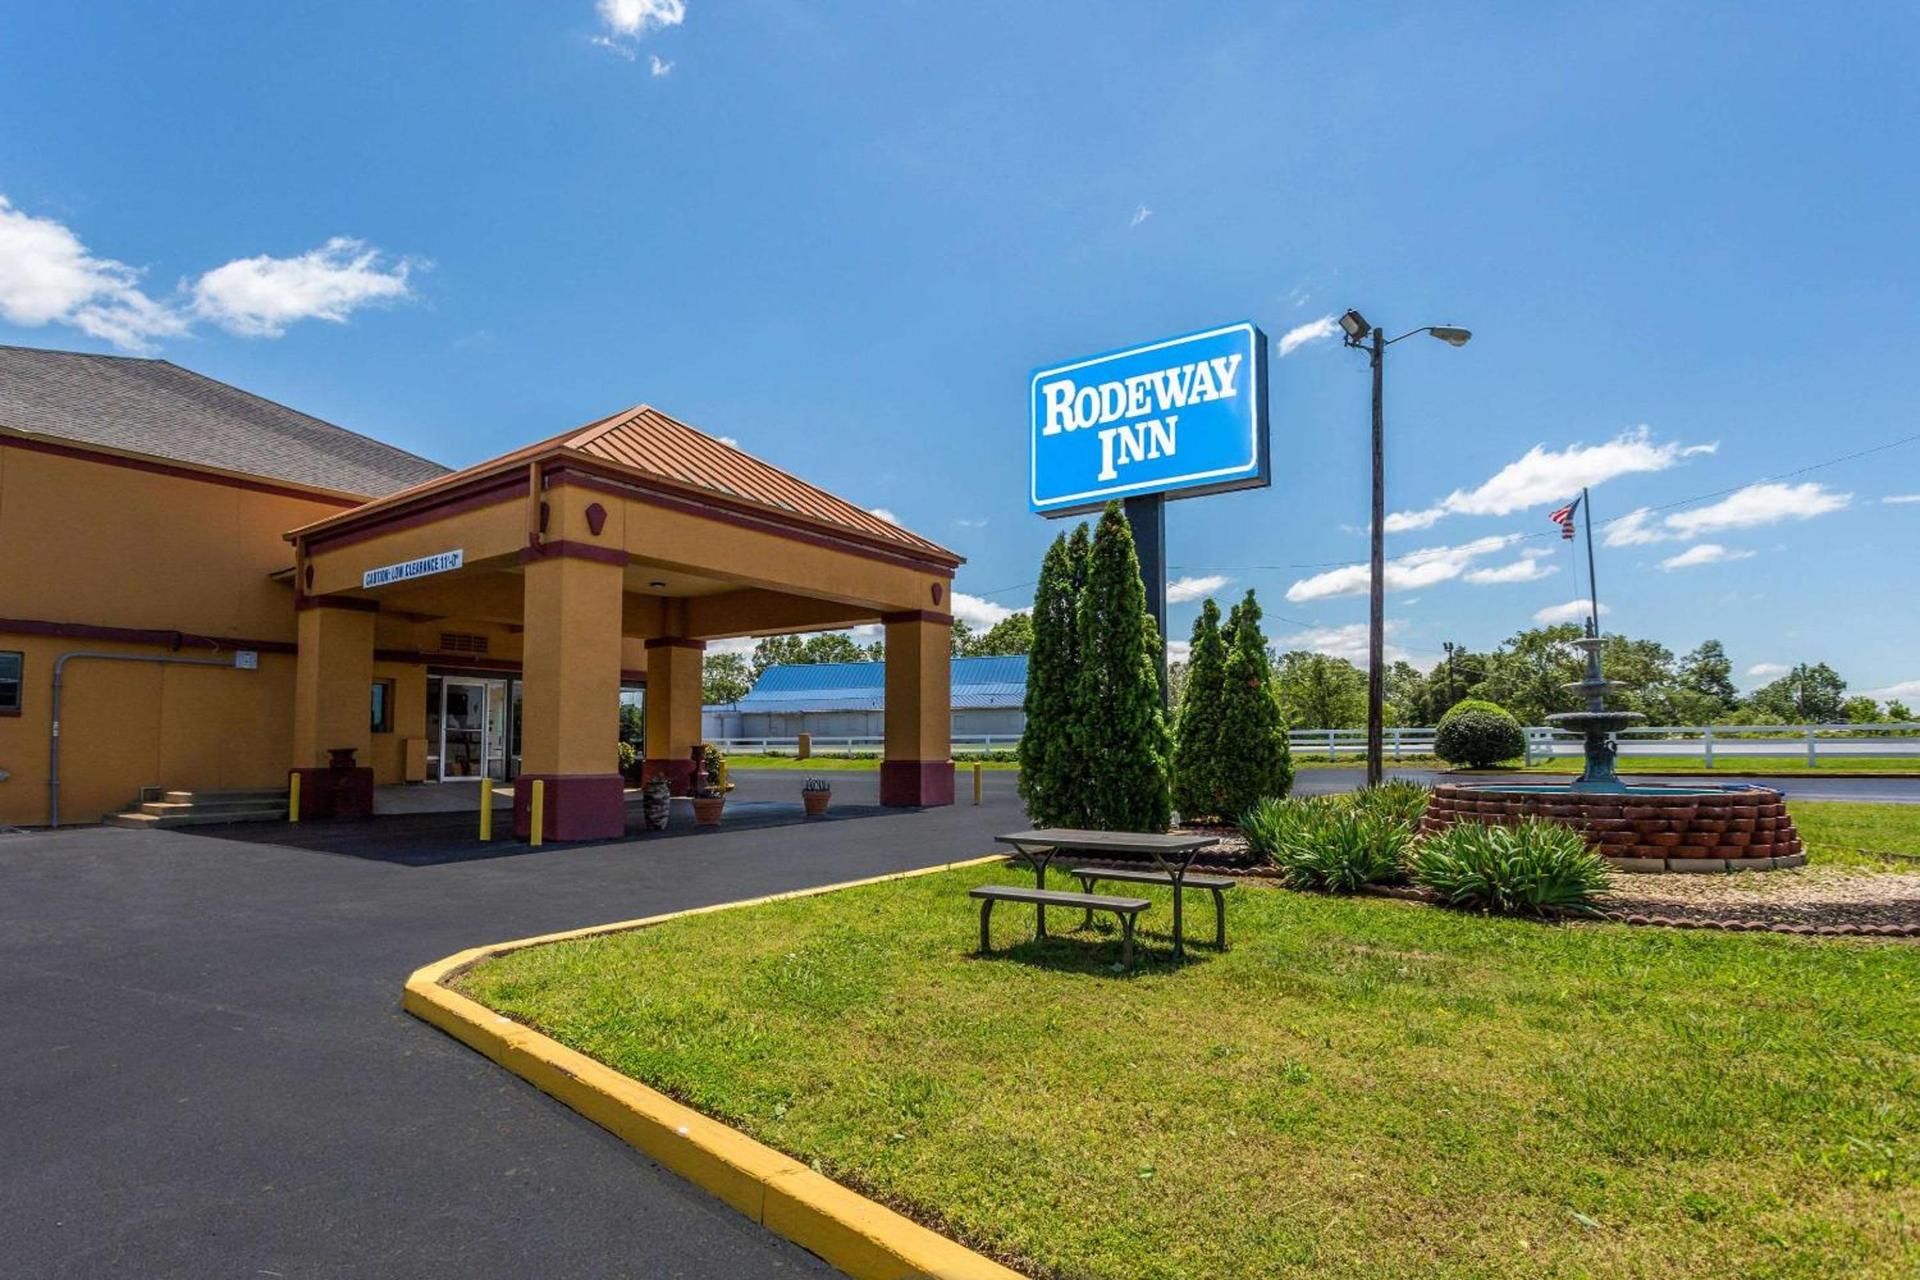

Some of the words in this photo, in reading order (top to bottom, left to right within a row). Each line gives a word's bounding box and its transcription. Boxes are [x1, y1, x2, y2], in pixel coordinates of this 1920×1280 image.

[1042, 354, 1242, 436] RODEWAY
[1097, 415, 1179, 482] INN
[391, 565, 404, 580] LOW
[405, 557, 439, 577] CLEARANCE
